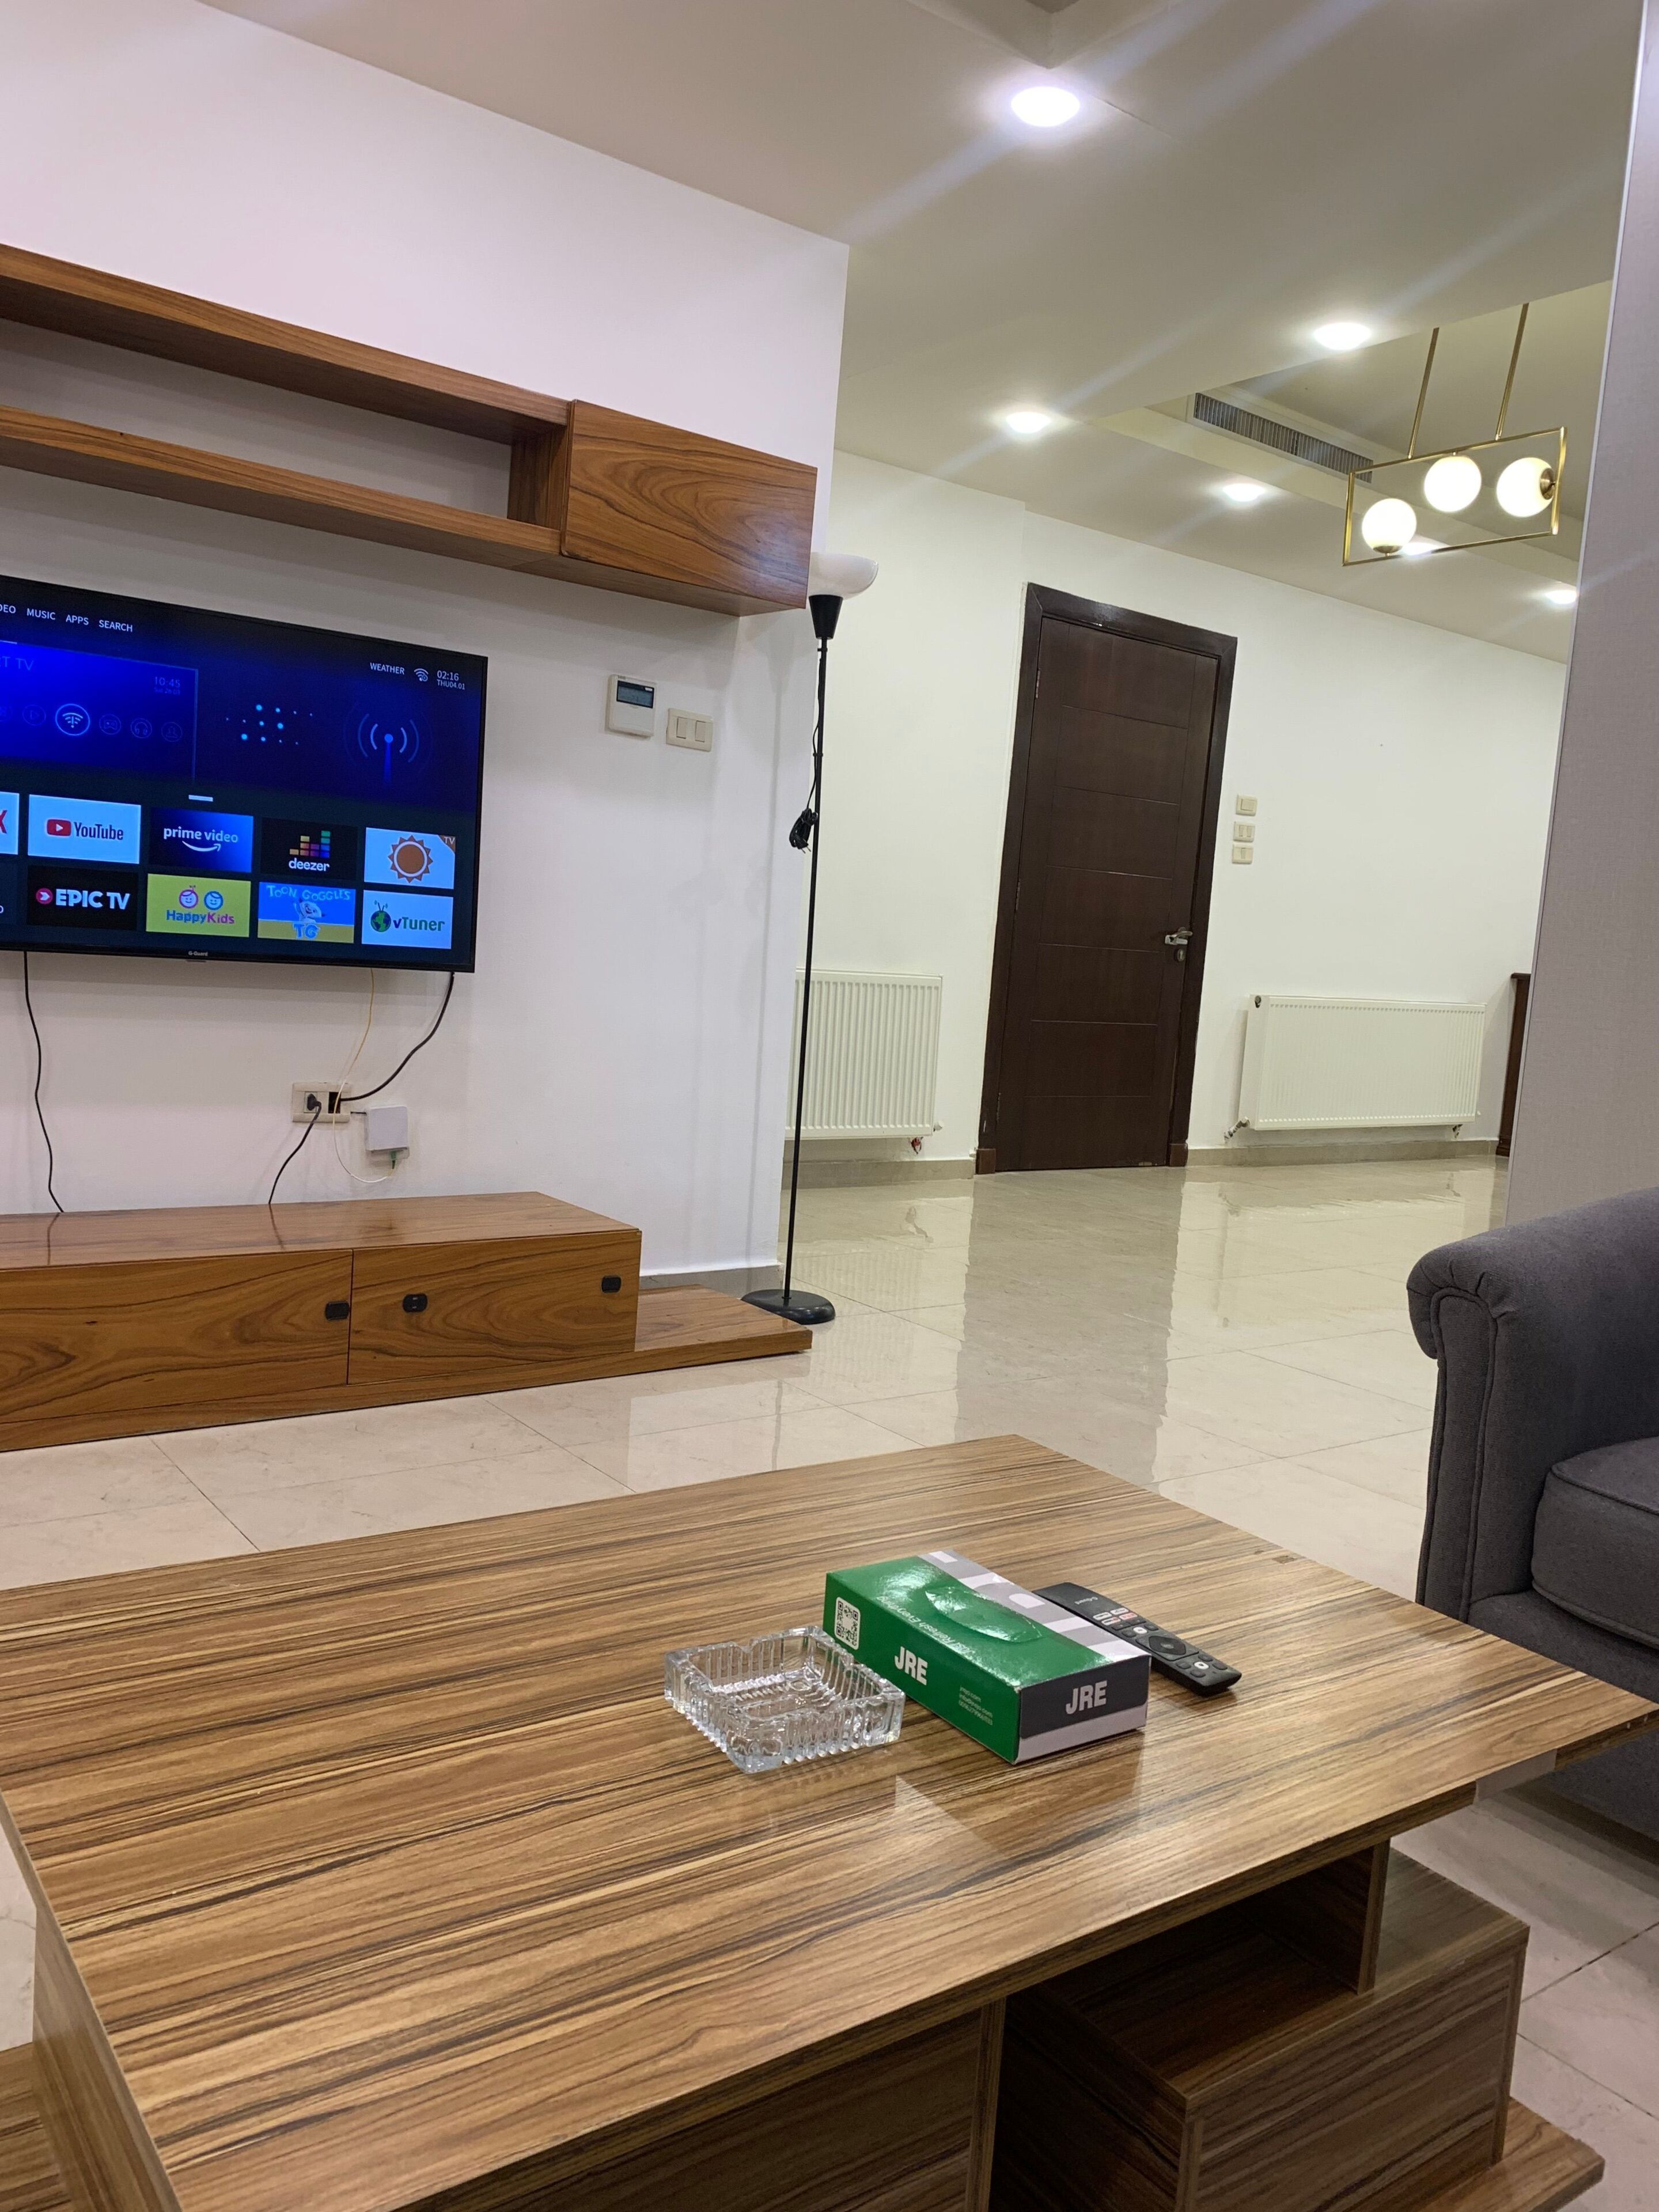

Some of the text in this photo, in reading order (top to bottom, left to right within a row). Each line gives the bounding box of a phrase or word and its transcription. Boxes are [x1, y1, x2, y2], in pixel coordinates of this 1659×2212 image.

[26, 608, 56, 620] MUSIC
[66, 615, 89, 626] APPS
[99, 619, 133, 632] SEARCH
[15, 658, 35, 671] TV
[370, 662, 405, 675] WEATHER
[437, 670, 459, 681] 02:16
[74, 821, 124, 840] YouTube
[164, 826, 238, 843] prime video
[444, 836, 456, 845] TV
[289, 858, 330, 872] deezer
[55, 888, 130, 910] EPIC TV
[166, 910, 235, 925] HappyKids
[393, 916, 445, 931] vTuner
[292, 923, 320, 940] TG
[894, 1646, 928, 1686] JRE
[1066, 1680, 1108, 1714] JRE
